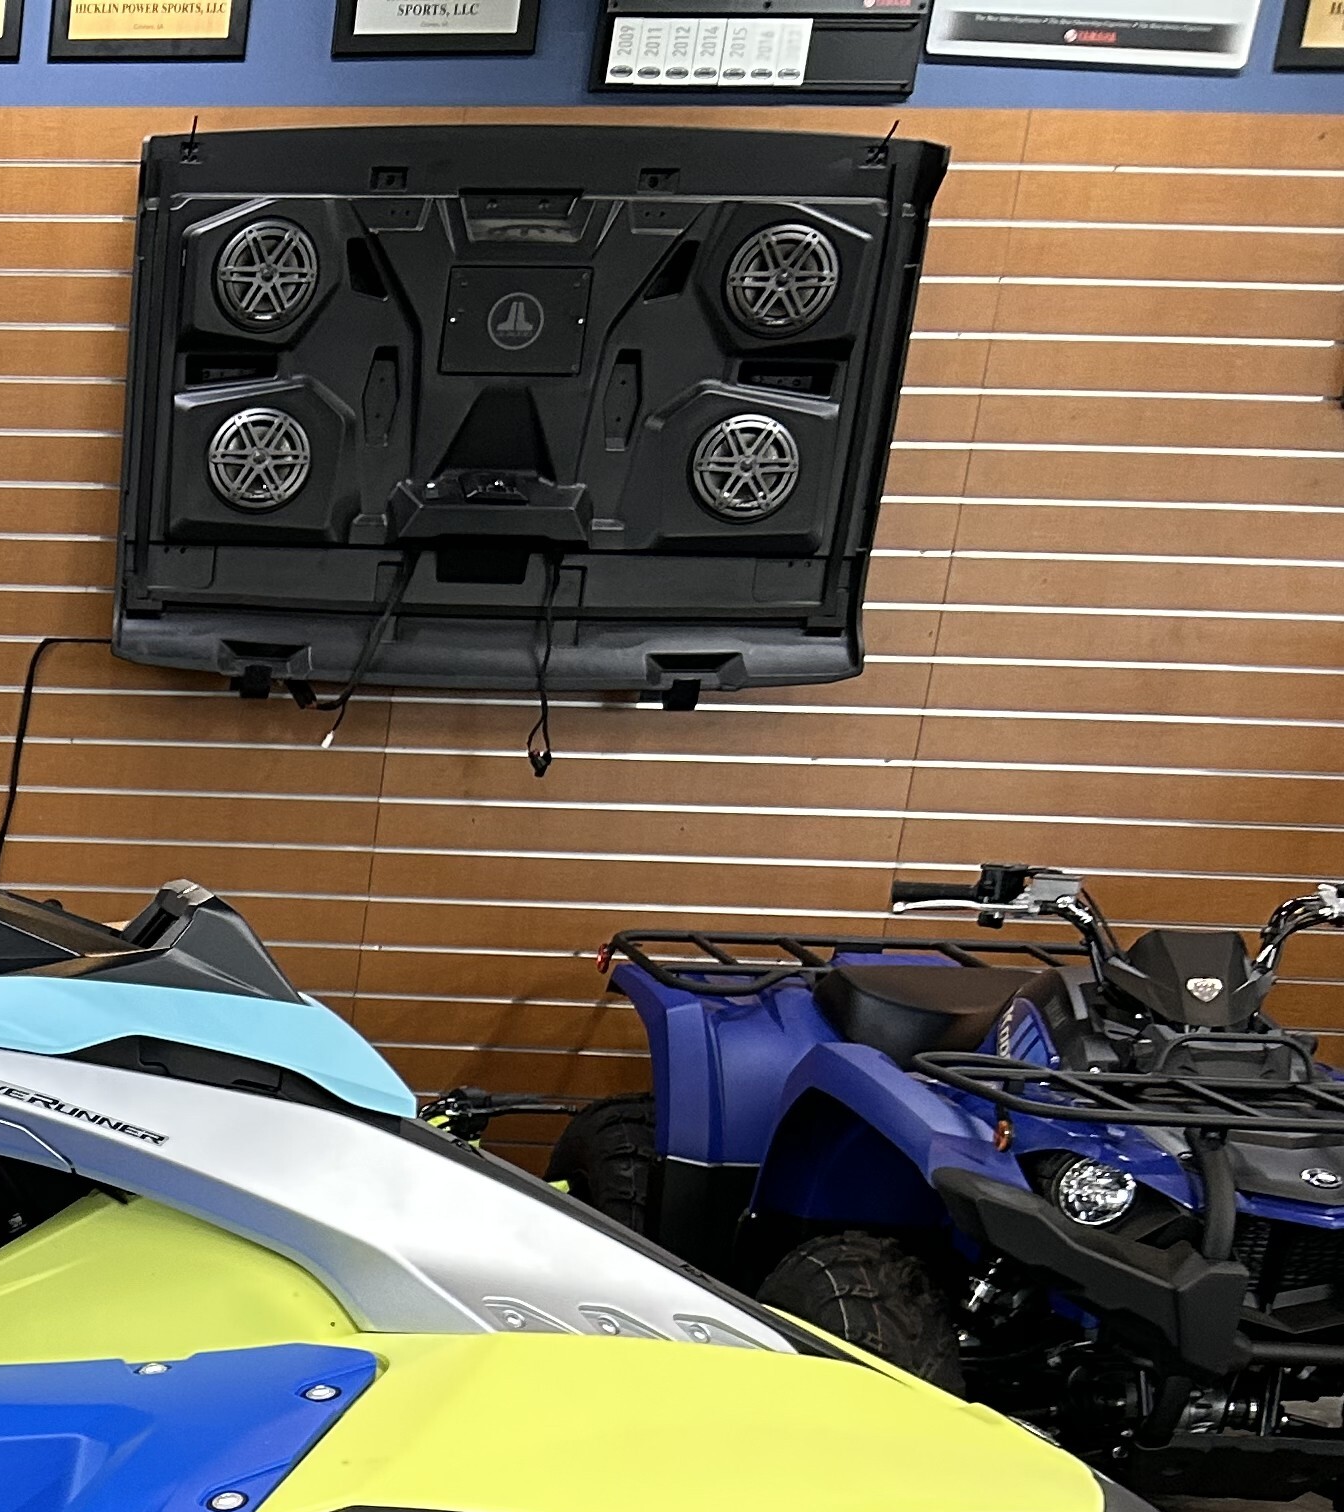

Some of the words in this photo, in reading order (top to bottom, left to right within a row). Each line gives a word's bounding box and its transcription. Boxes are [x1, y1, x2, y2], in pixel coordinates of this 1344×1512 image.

[75, 3, 119, 14] HICKLIN
[122, 3, 159, 14] POWER
[161, 3, 204, 15] SPORTS,
[206, 3, 226, 14] LLC
[397, 3, 450, 17] SPORTS,
[454, 4, 480, 15] LLC
[616, 25, 635, 56] 2009
[644, 27, 663, 57] 2011
[672, 26, 691, 57] 2012
[700, 26, 719, 57] 2014
[729, 27, 748, 58] 2015
